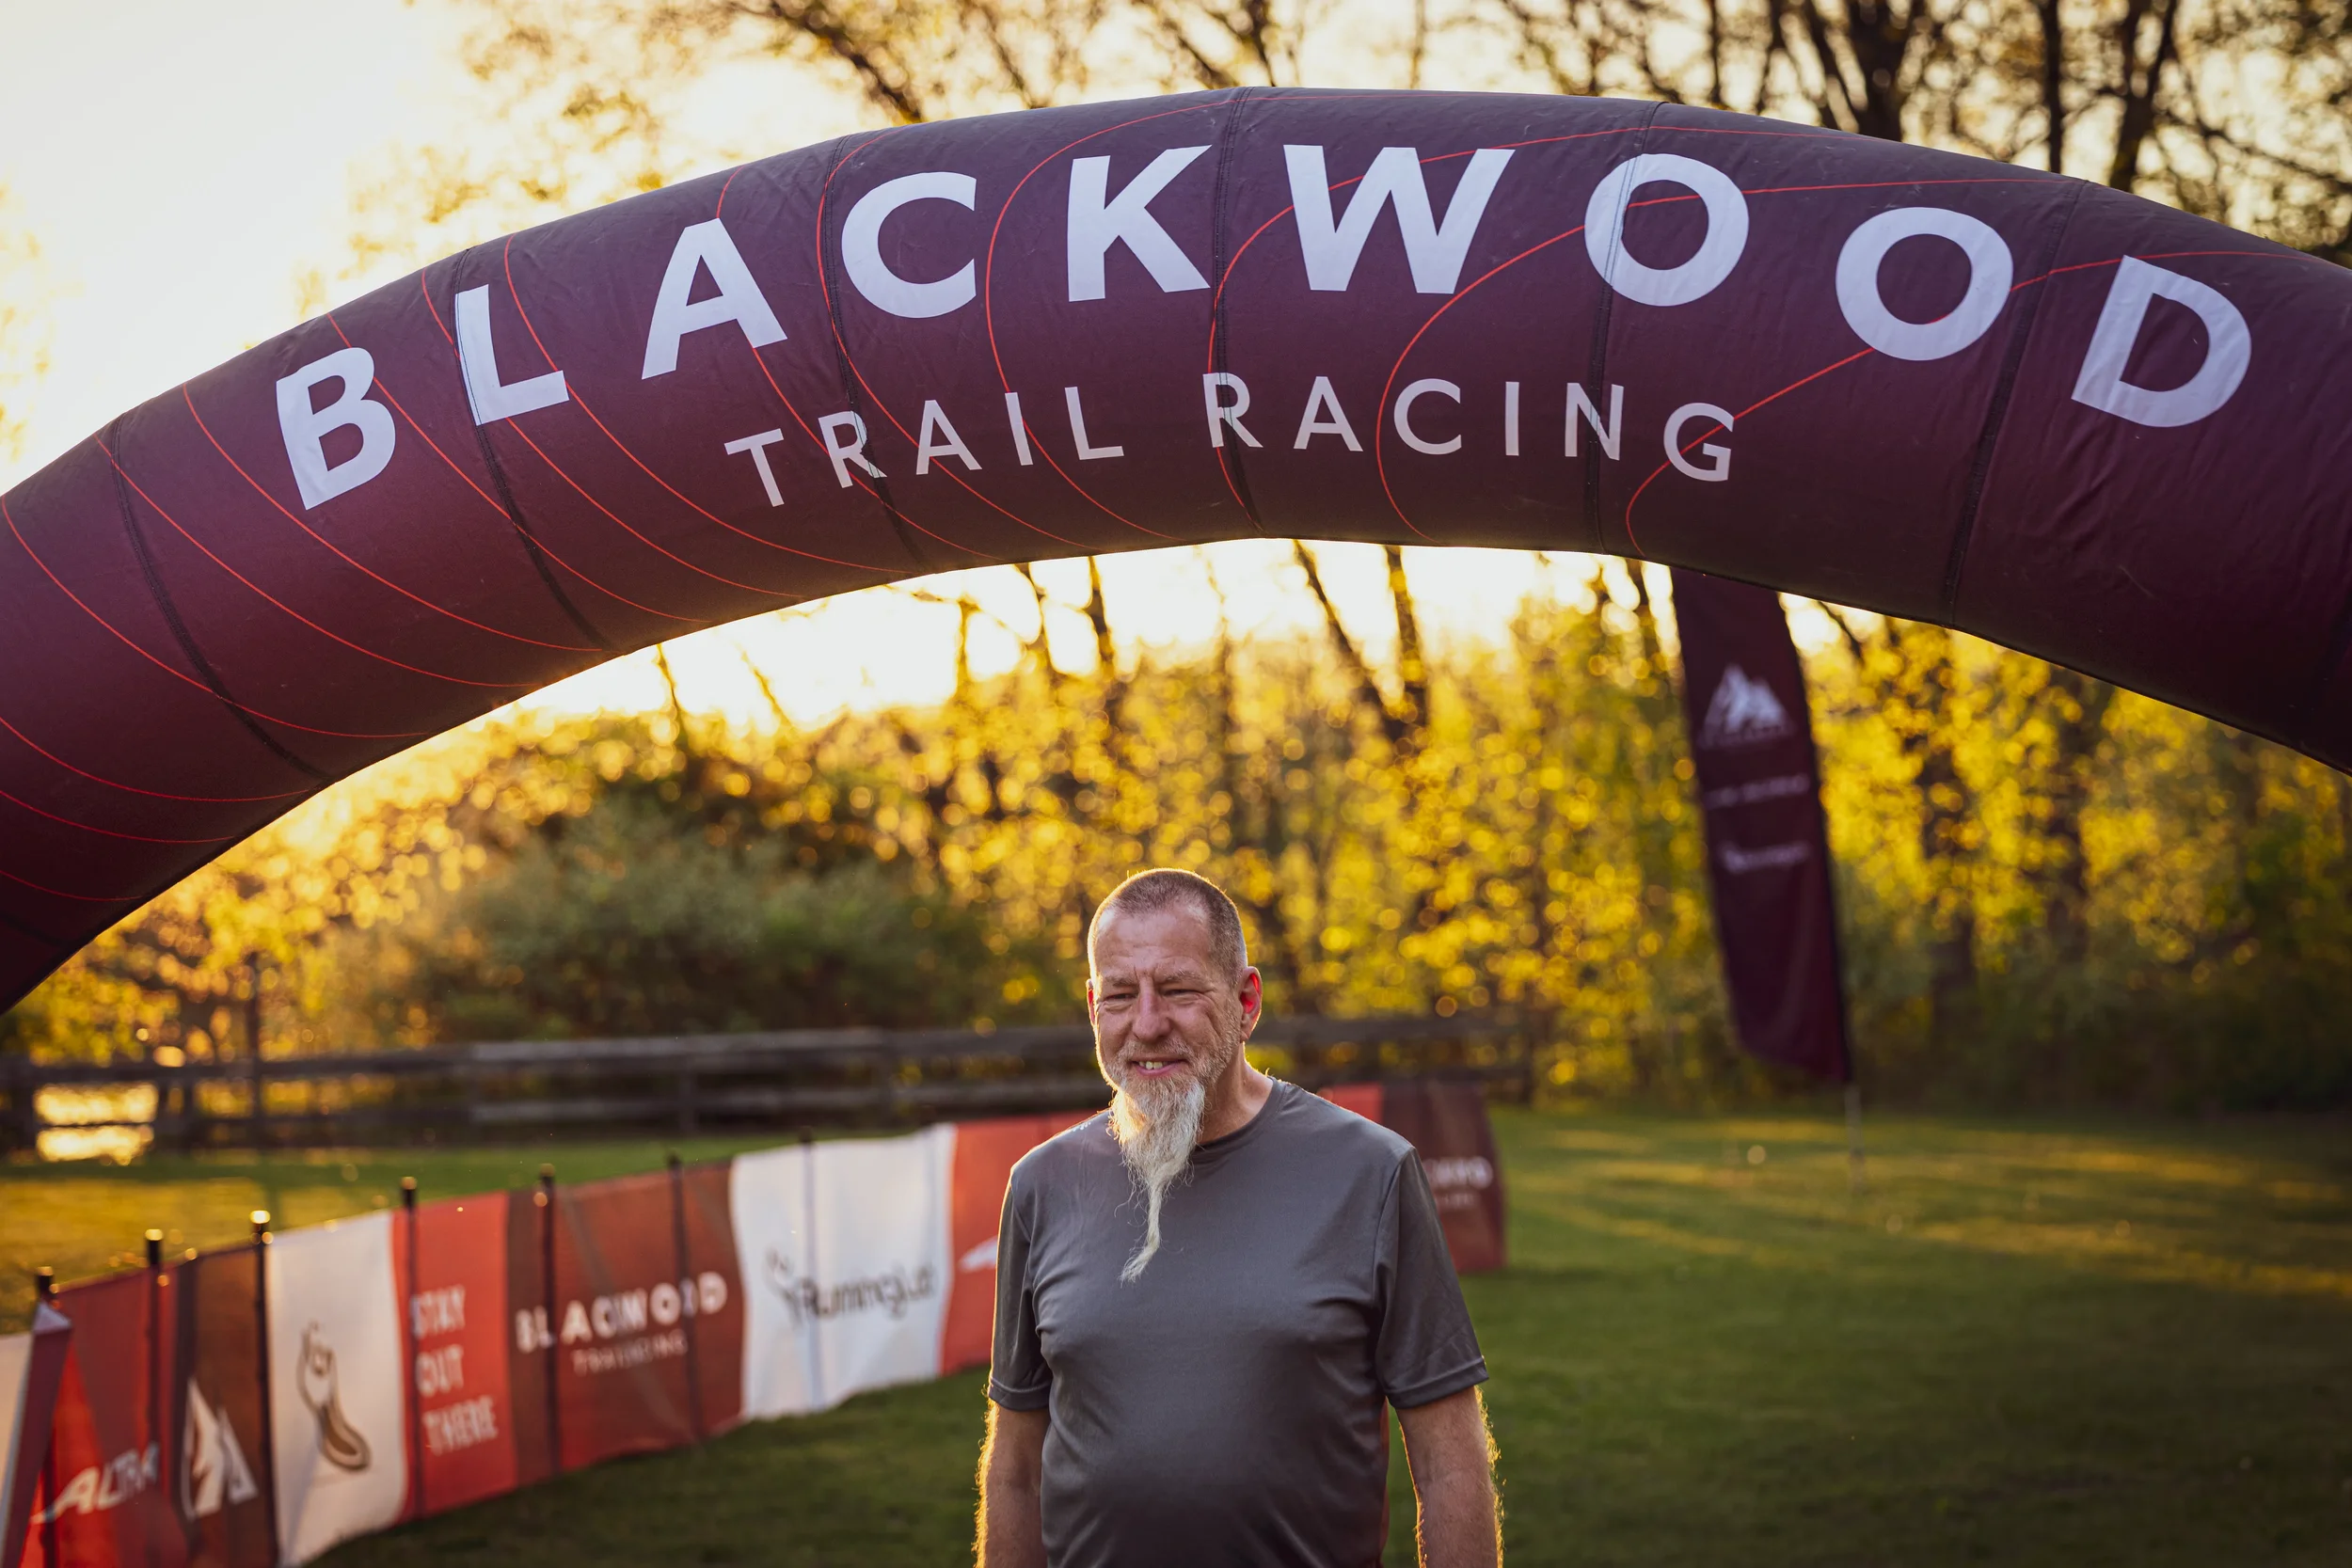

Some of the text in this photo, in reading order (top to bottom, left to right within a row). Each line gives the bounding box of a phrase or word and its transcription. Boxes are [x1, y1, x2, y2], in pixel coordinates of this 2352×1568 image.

[276, 144, 2251, 511] BLACKWOOD
[723, 372, 1737, 507] TRAIL RACING
[409, 1284, 466, 1339] STAY
[415, 1343, 465, 1398] OUT
[421, 1394, 499, 1456] THERE
